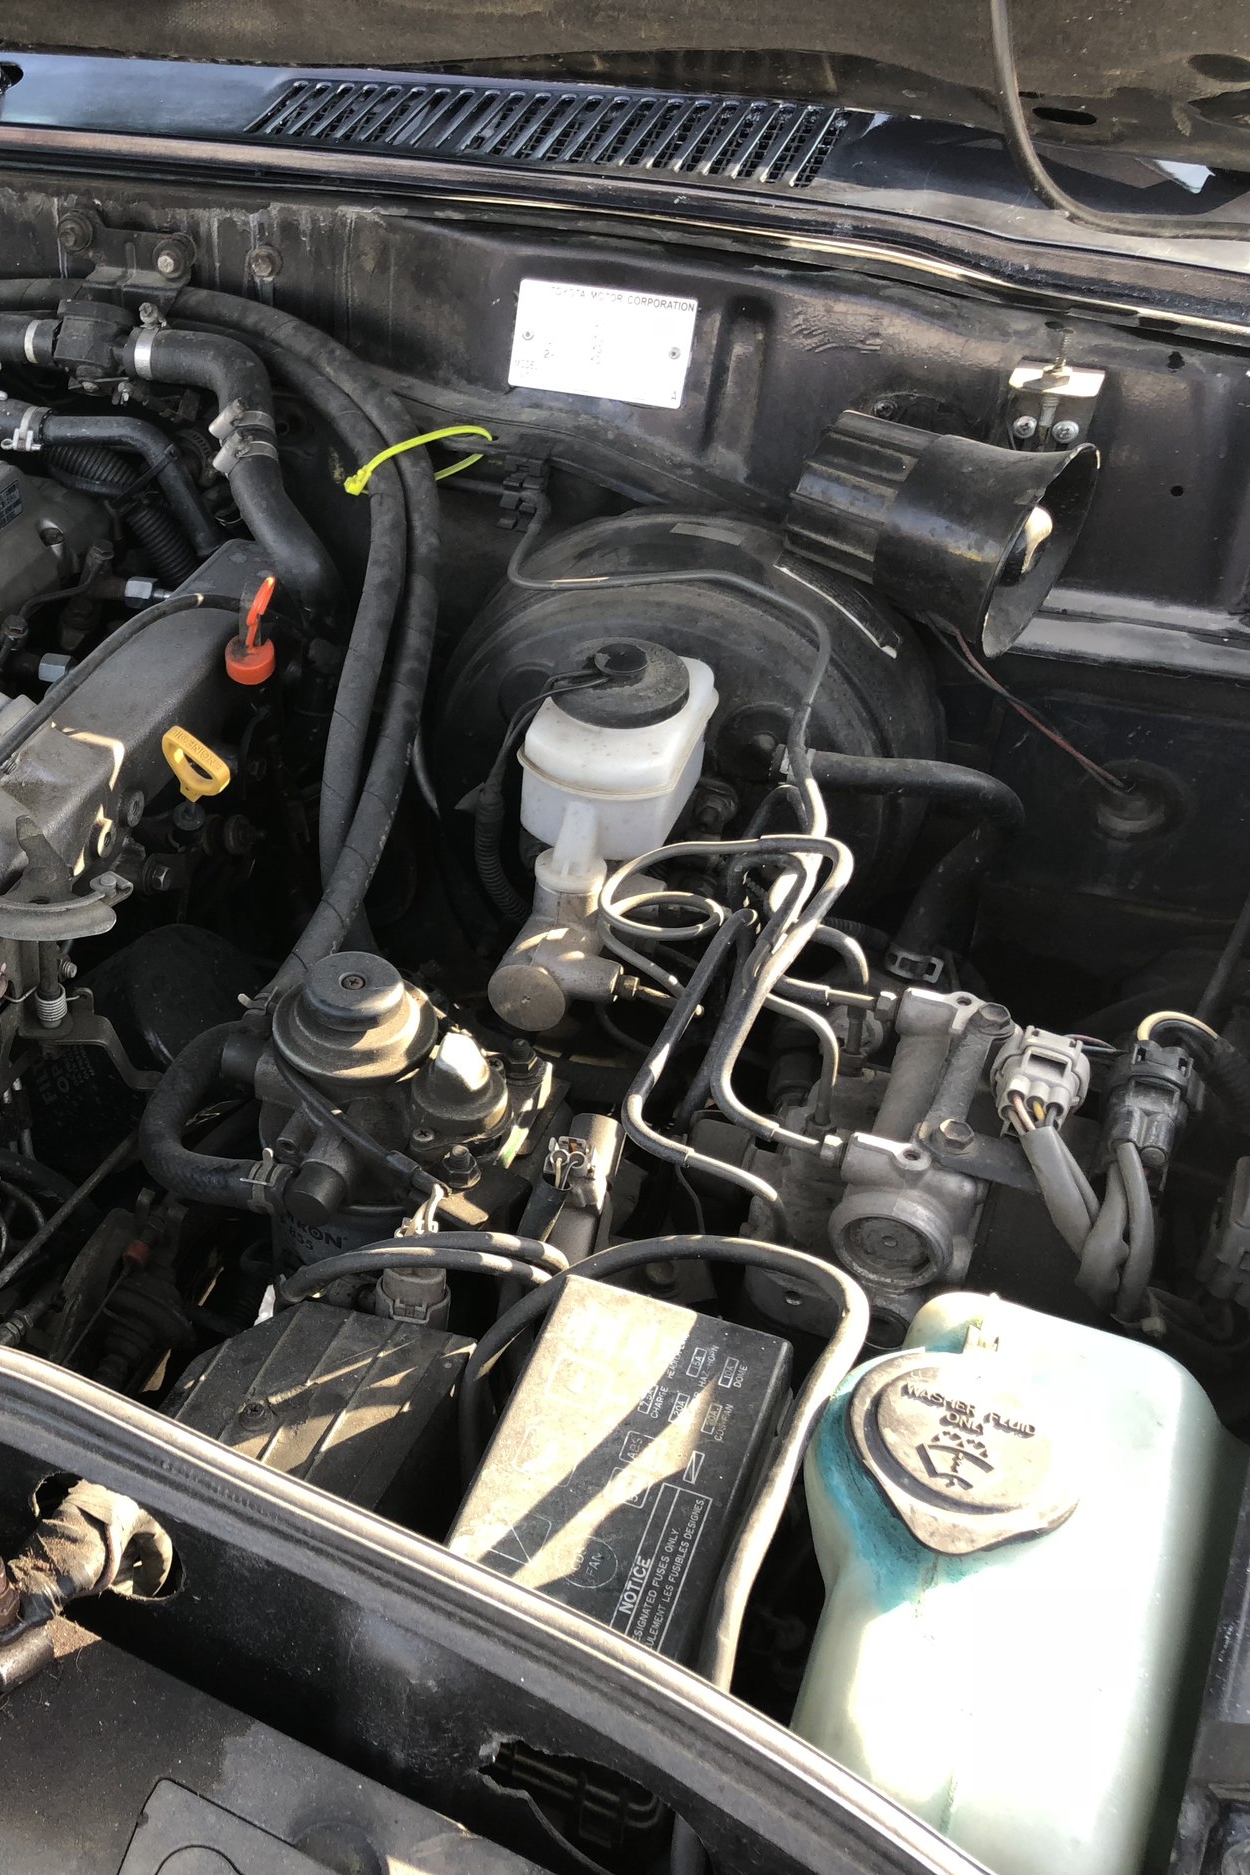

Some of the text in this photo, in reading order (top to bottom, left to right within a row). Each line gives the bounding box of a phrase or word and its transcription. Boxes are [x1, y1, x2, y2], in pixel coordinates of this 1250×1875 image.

[627, 295, 695, 312] CORPORATION
[722, 1363, 735, 1380] 10A
[732, 1363, 748, 1388] DOME
[649, 1384, 669, 1419] CHARGE
[904, 1383, 1036, 1437] WASHER FLUID
[585, 1551, 603, 1577] FAN
[667, 1540, 690, 1583] FUSIBLES
[619, 1554, 650, 1614] NOTICE
[631, 1588, 657, 1642] ESIGNATED
[651, 1552, 670, 1587] FUSES
[661, 1582, 675, 1603] LES
[644, 1602, 668, 1649] ULEMENT
